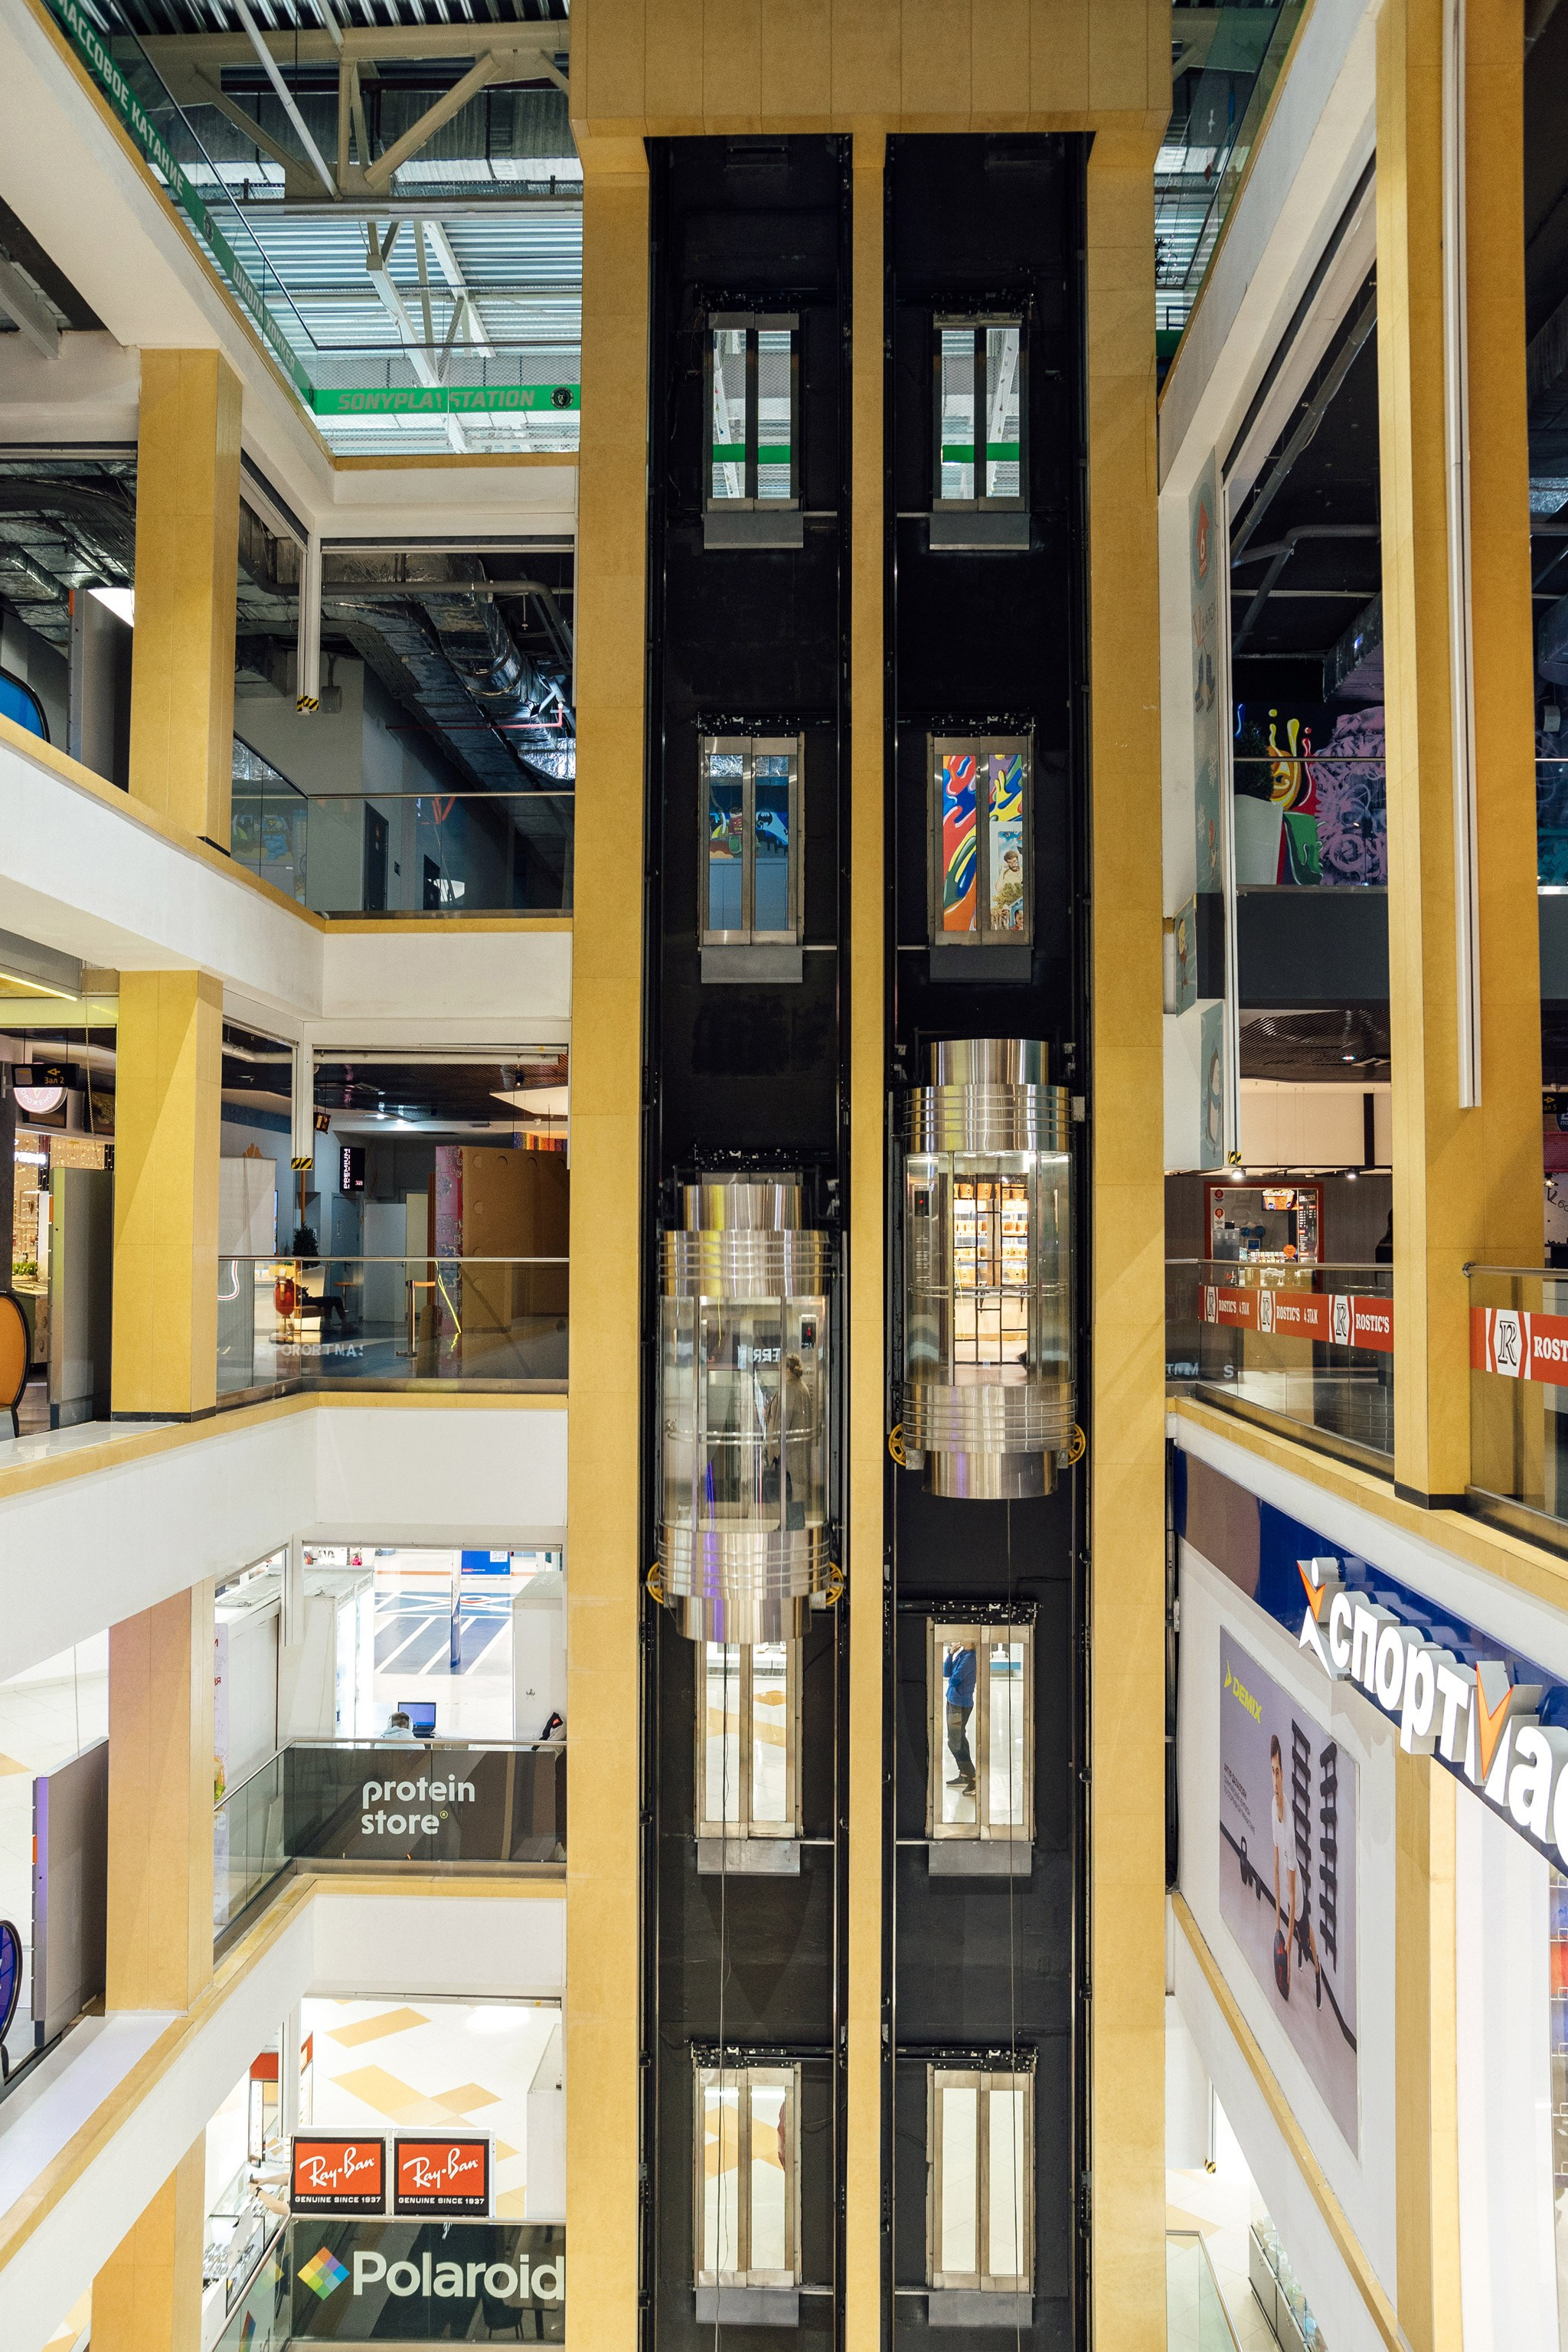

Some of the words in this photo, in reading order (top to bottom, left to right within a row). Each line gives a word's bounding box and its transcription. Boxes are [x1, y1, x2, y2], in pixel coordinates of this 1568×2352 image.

[132, 101, 184, 196] КАТАНИЕ
[233, 261, 263, 323] ШКОЛА
[1219, 1299, 1236, 1314] ROSTIC'S
[1276, 1305, 1300, 1322] ROSTIC'S
[1307, 1308, 1318, 1325] ЭТАЖ
[1356, 1313, 1390, 1334] ROSTIC'S
[1534, 1335, 1568, 1363] ROST
[1233, 1676, 1263, 1724] DEMIX
[362, 1774, 475, 1809] protein
[465, 2197, 485, 2205] 1937
[352, 2250, 565, 2301] Polaroid
